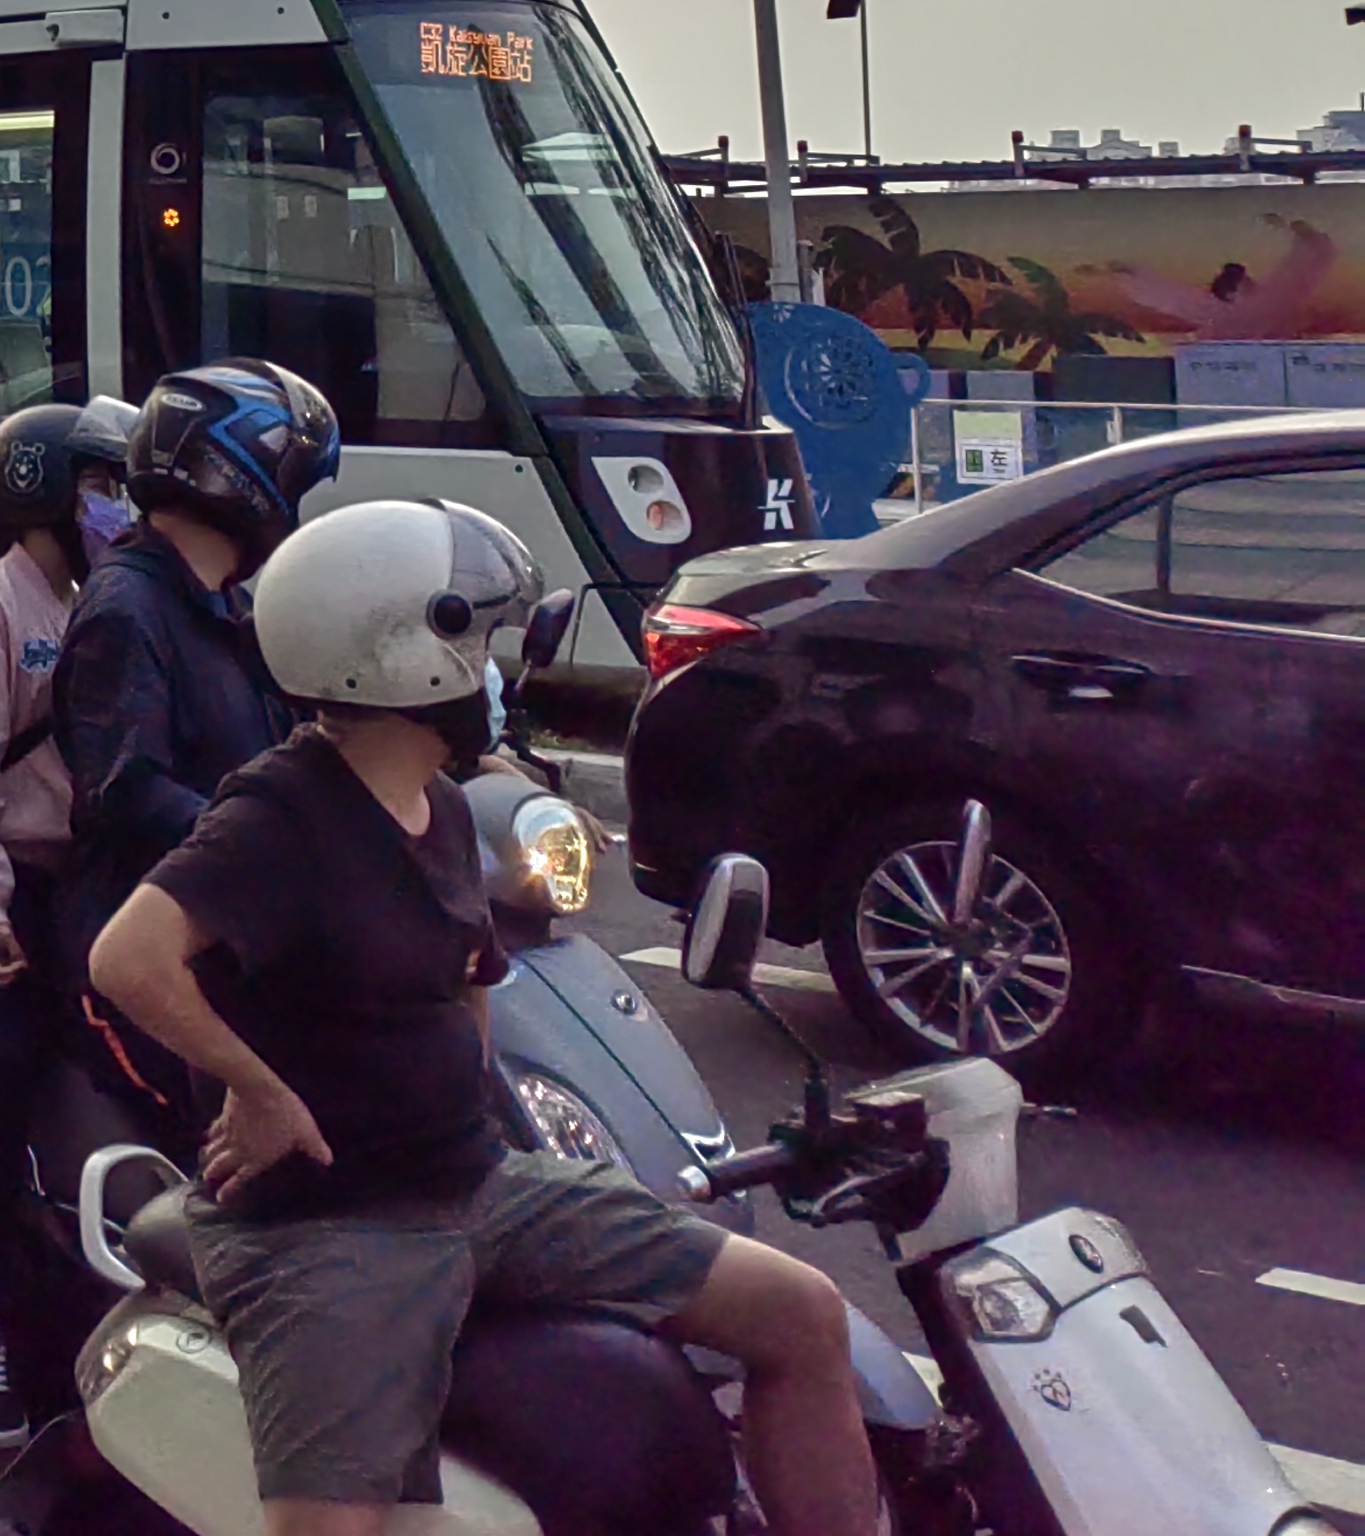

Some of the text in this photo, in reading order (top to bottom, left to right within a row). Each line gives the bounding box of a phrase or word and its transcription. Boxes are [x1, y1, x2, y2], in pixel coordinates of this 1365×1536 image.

[506, 31, 534, 50] Park
[420, 40, 533, 83] 凱旋公園站
